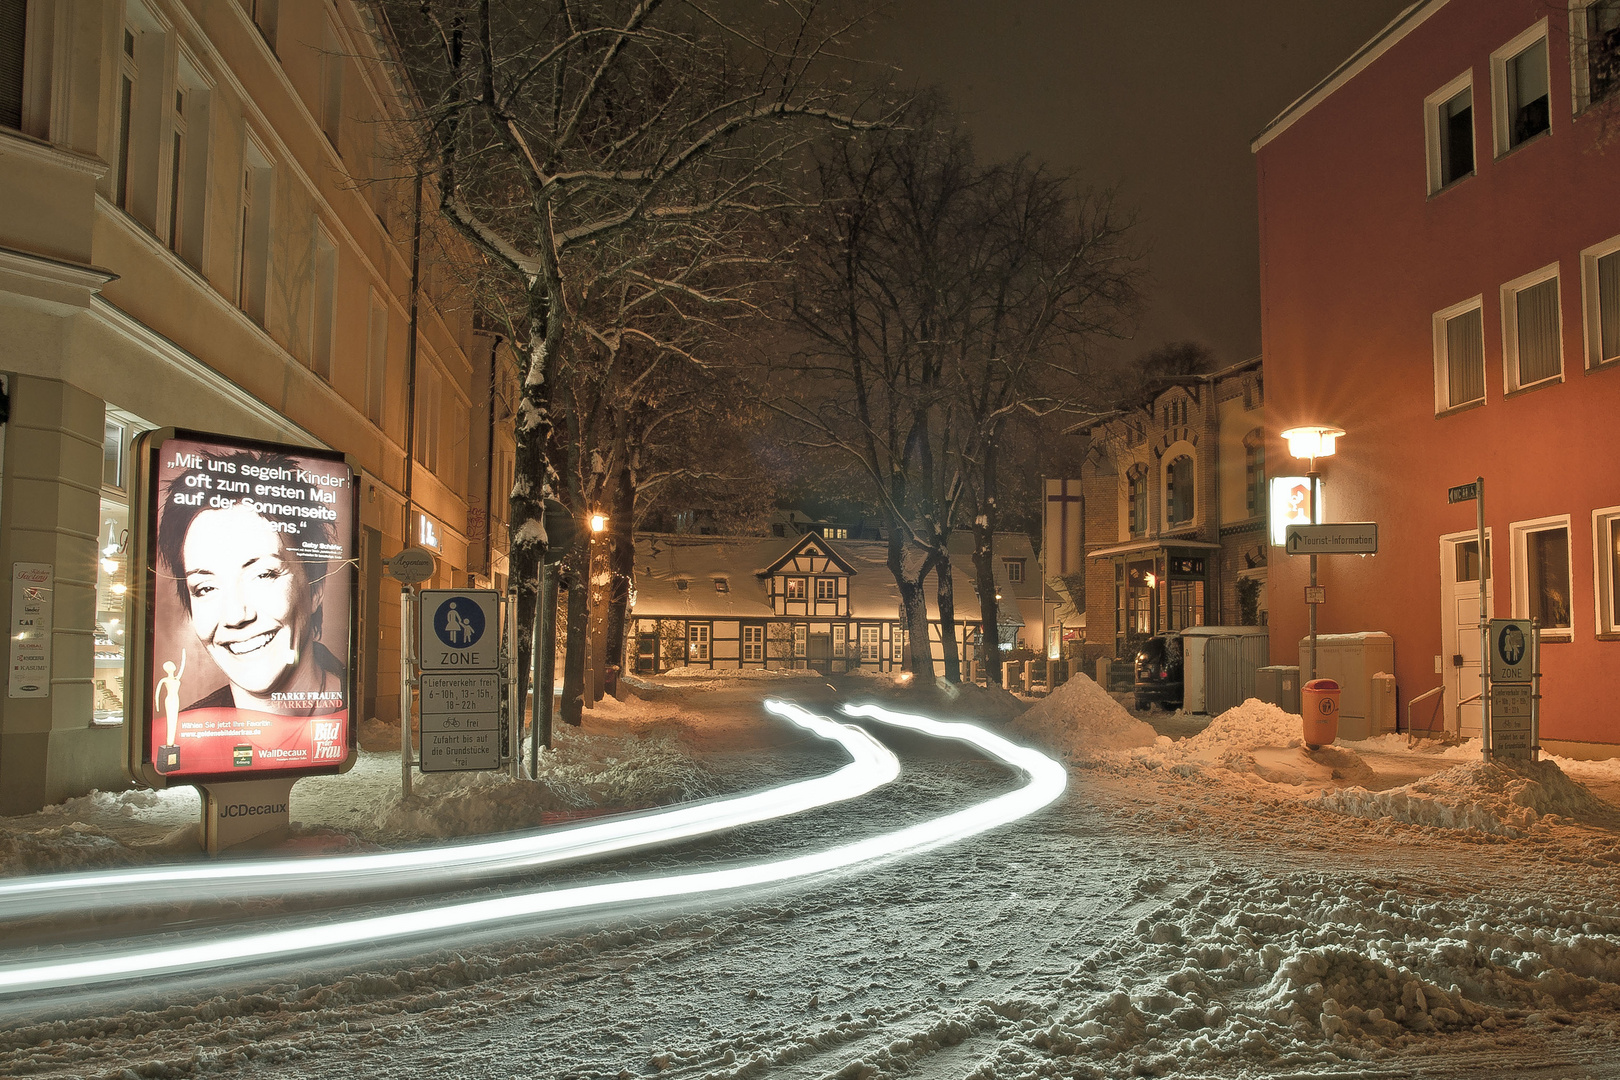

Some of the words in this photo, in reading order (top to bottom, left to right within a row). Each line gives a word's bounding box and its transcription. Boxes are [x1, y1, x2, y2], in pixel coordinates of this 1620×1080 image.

[207, 459, 236, 474] uns
[241, 465, 291, 481] segeln
[296, 470, 345, 488] Kinder
[185, 474, 212, 489] oft
[217, 479, 250, 493] zum
[254, 484, 305, 500] ersten
[310, 488, 336, 503] Mal
[173, 492, 205, 506] auf
[209, 495, 236, 509] der
[242, 497, 337, 520] Sonnenseite
[1303, 534, 1373, 545] Tourist-Information
[394, 556, 430, 567] Argentum
[441, 652, 480, 665] ZONE
[1501, 668, 1522, 678] ZONE
[429, 679, 476, 688] Lieferverkehr
[480, 677, 492, 686] frei
[271, 692, 305, 700] STARKE
[308, 691, 343, 700] FRAUEN
[316, 700, 343, 708] LAND
[217, 721, 231, 729] jetzt
[466, 718, 479, 728] frei
[314, 722, 340, 740] Bild
[433, 735, 460, 744] Zufahrt
[462, 735, 473, 743] bis
[476, 734, 489, 743] auf
[258, 749, 307, 758] WallDecaux
[314, 741, 341, 759] Frau
[431, 748, 443, 756] die
[446, 745, 490, 755] Grundstücke
[455, 757, 468, 766] frei
[220, 803, 287, 818] JCDecaux
